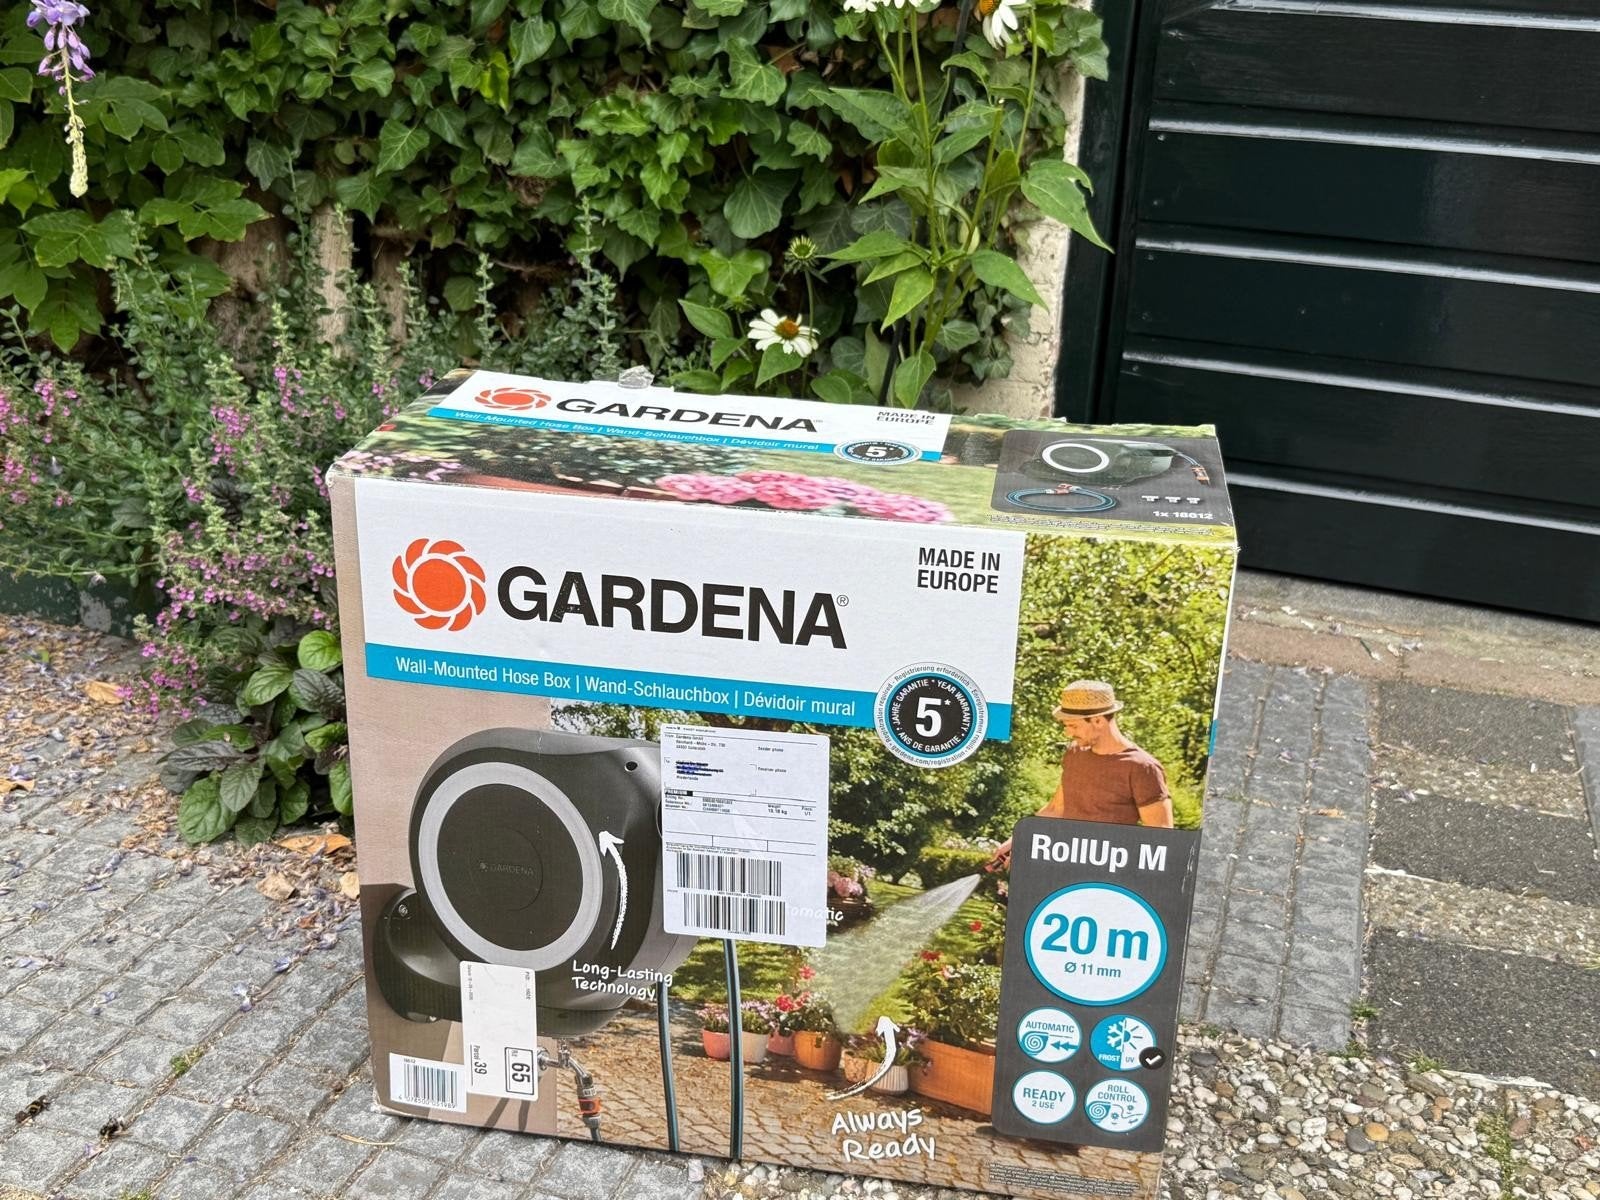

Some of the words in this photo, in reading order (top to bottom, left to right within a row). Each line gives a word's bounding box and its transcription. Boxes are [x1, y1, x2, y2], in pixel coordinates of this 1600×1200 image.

[556, 398, 818, 433] GARDENA
[876, 416, 935, 425] EUROPE
[877, 411, 918, 419] MADE
[455, 411, 537, 426] Wall-Mounted
[540, 420, 569, 429] Hose
[572, 424, 597, 433] Box
[605, 427, 720, 443] Wand-Schlauchbox
[783, 443, 820, 451] mural
[918, 547, 975, 569] MADE
[981, 552, 1001, 571] IN
[917, 569, 999, 594] EUROPE
[496, 564, 848, 650] GARDENA
[395, 656, 498, 682] Wall-Mounted
[502, 667, 539, 685] Hose
[543, 671, 571, 689] Box
[584, 675, 730, 705] Wand-Schlauchbox
[743, 691, 807, 712] Dévidoir
[811, 700, 856, 717] mural
[895, 678, 929, 702] GARANTIE
[937, 680, 955, 694] YEAR
[891, 702, 901, 727] JAHRE
[955, 691, 971, 732] WARRANTY
[898, 731, 913, 745] ANS
[912, 740, 925, 751] DE
[924, 735, 962, 753] GARANTIE
[1030, 833, 1128, 873] RollUp
[1138, 843, 1167, 872] M
[1041, 913, 1098, 955] 20
[1106, 928, 1149, 962] m
[572, 959, 673, 987] Long-Lasting
[1080, 963, 1093, 975] 11
[1096, 967, 1121, 978] mm
[571, 976, 656, 1001] Technology
[1025, 1020, 1075, 1034] AUTOMATIC
[474, 1061, 488, 1075] 39
[1098, 1053, 1121, 1062] FROST
[511, 1062, 531, 1083] 65
[1022, 1087, 1066, 1103] READY
[1097, 1091, 1137, 1104] CONTROL
[1107, 1084, 1129, 1094] ROLL
[1032, 1100, 1037, 1108] 2
[1038, 1100, 1056, 1109] USE
[831, 1108, 923, 1136] Always
[842, 1133, 936, 1163] Ready
